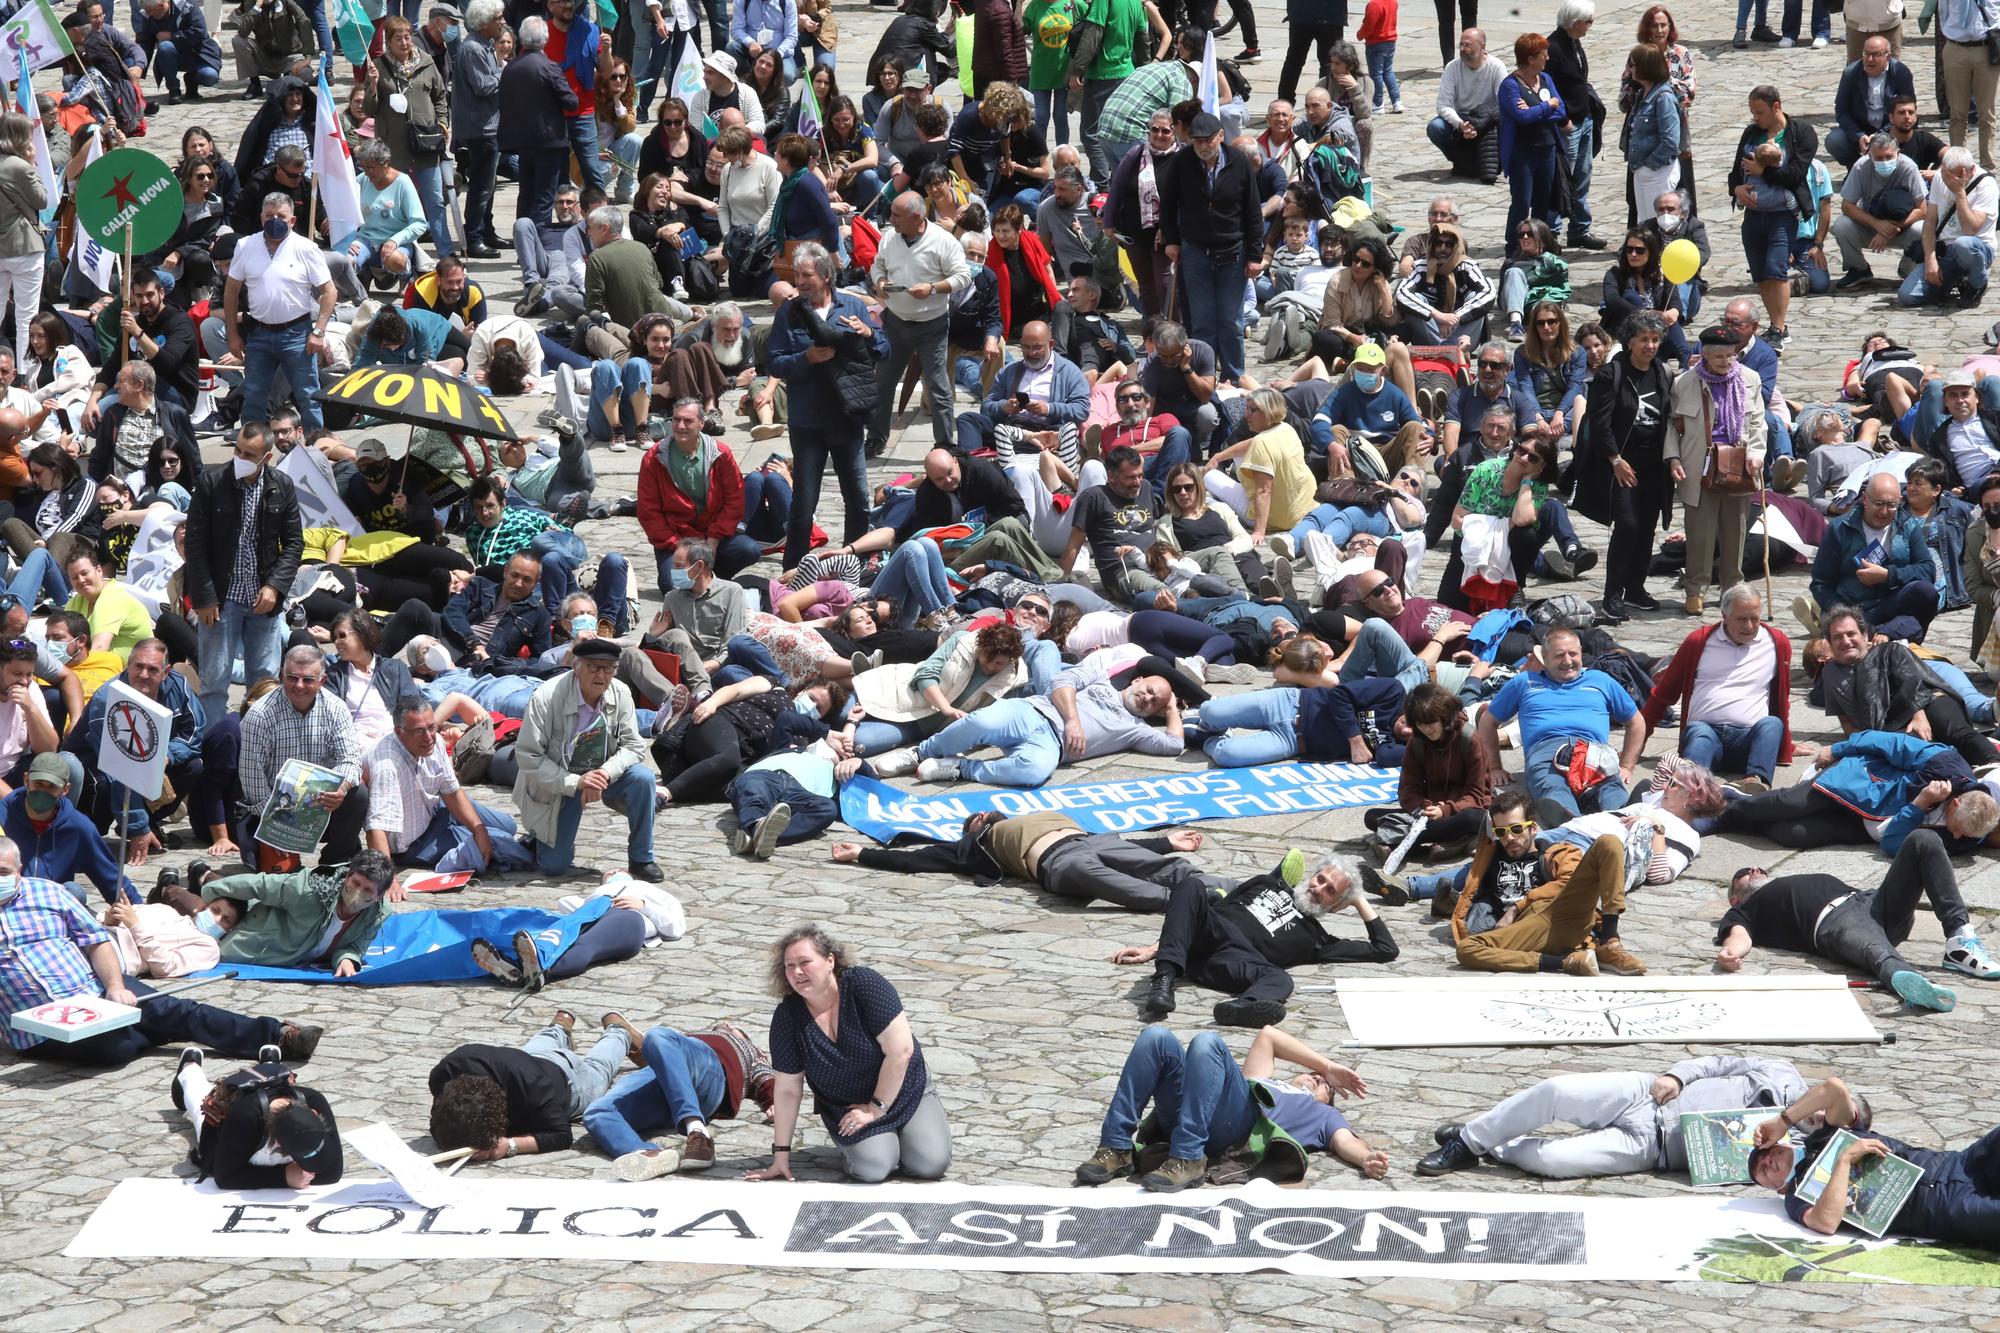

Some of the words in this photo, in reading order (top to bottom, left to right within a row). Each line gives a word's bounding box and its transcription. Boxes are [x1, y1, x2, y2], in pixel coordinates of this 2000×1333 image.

[101, 204, 140, 237] GALIZA
[139, 177, 171, 205] NOVA
[327, 367, 463, 420] NON
[867, 792, 972, 822] NON
[992, 772, 1242, 816] QUEREMOS
[1093, 801, 1200, 832] DOS
[825, 1207, 1077, 1249] ASÍ
[1144, 1206, 1489, 1253] NON!
